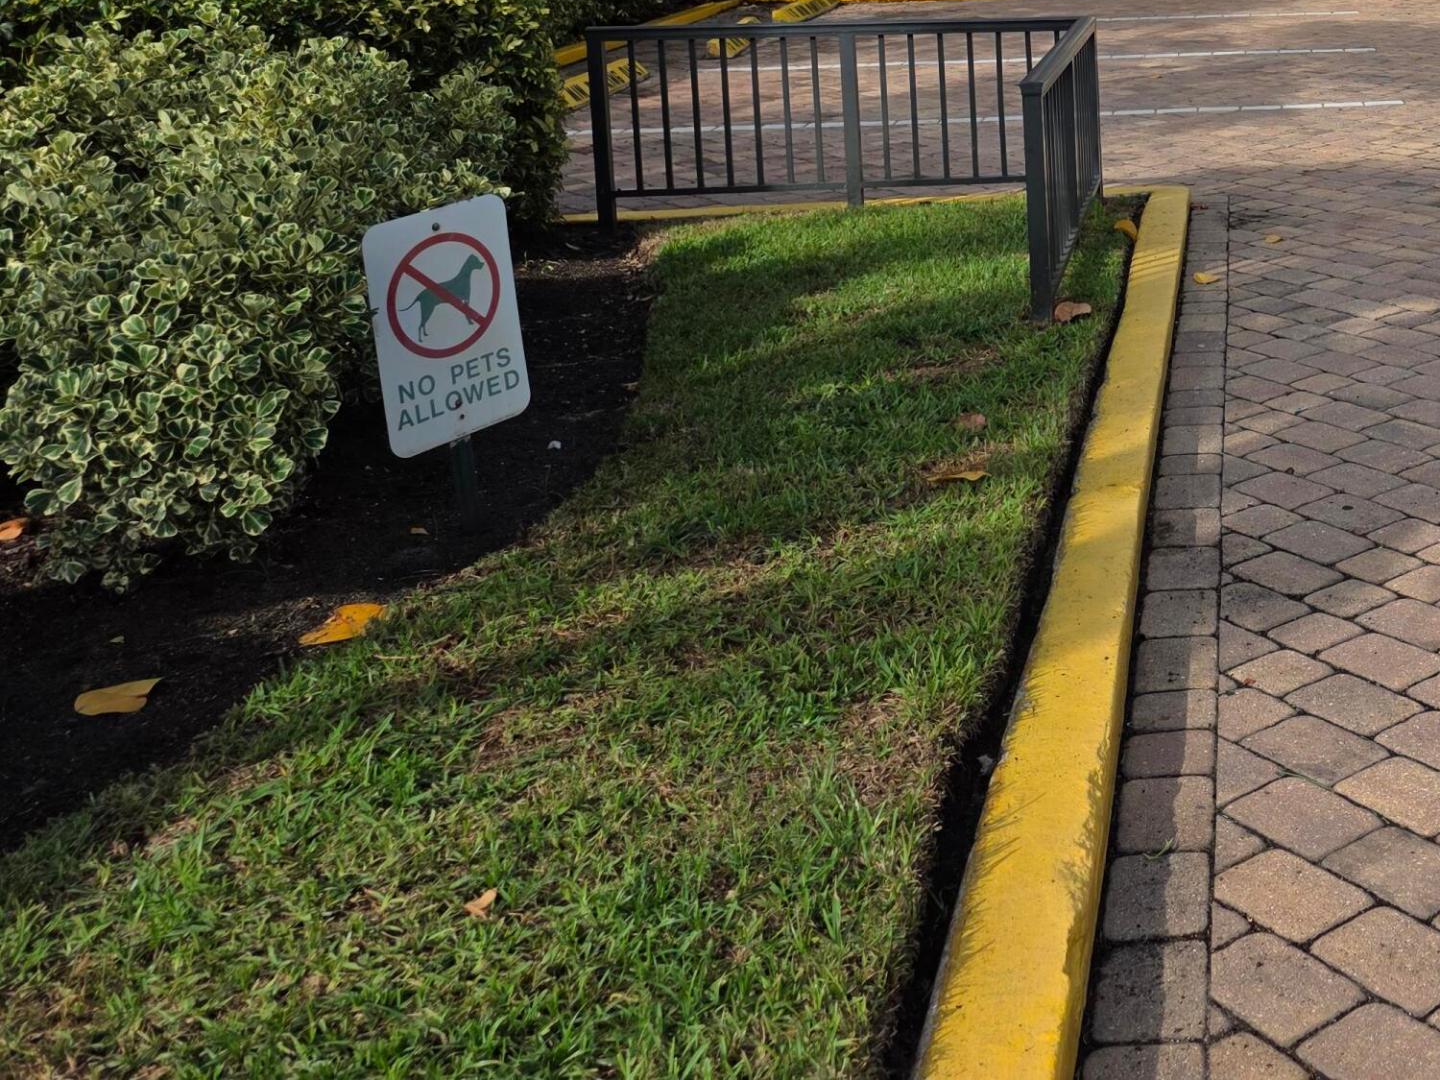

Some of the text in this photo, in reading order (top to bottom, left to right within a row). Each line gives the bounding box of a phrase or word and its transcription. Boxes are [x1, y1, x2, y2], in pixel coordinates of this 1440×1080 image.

[397, 347, 511, 403] NO PETS
[397, 370, 520, 431] ALLOWED
